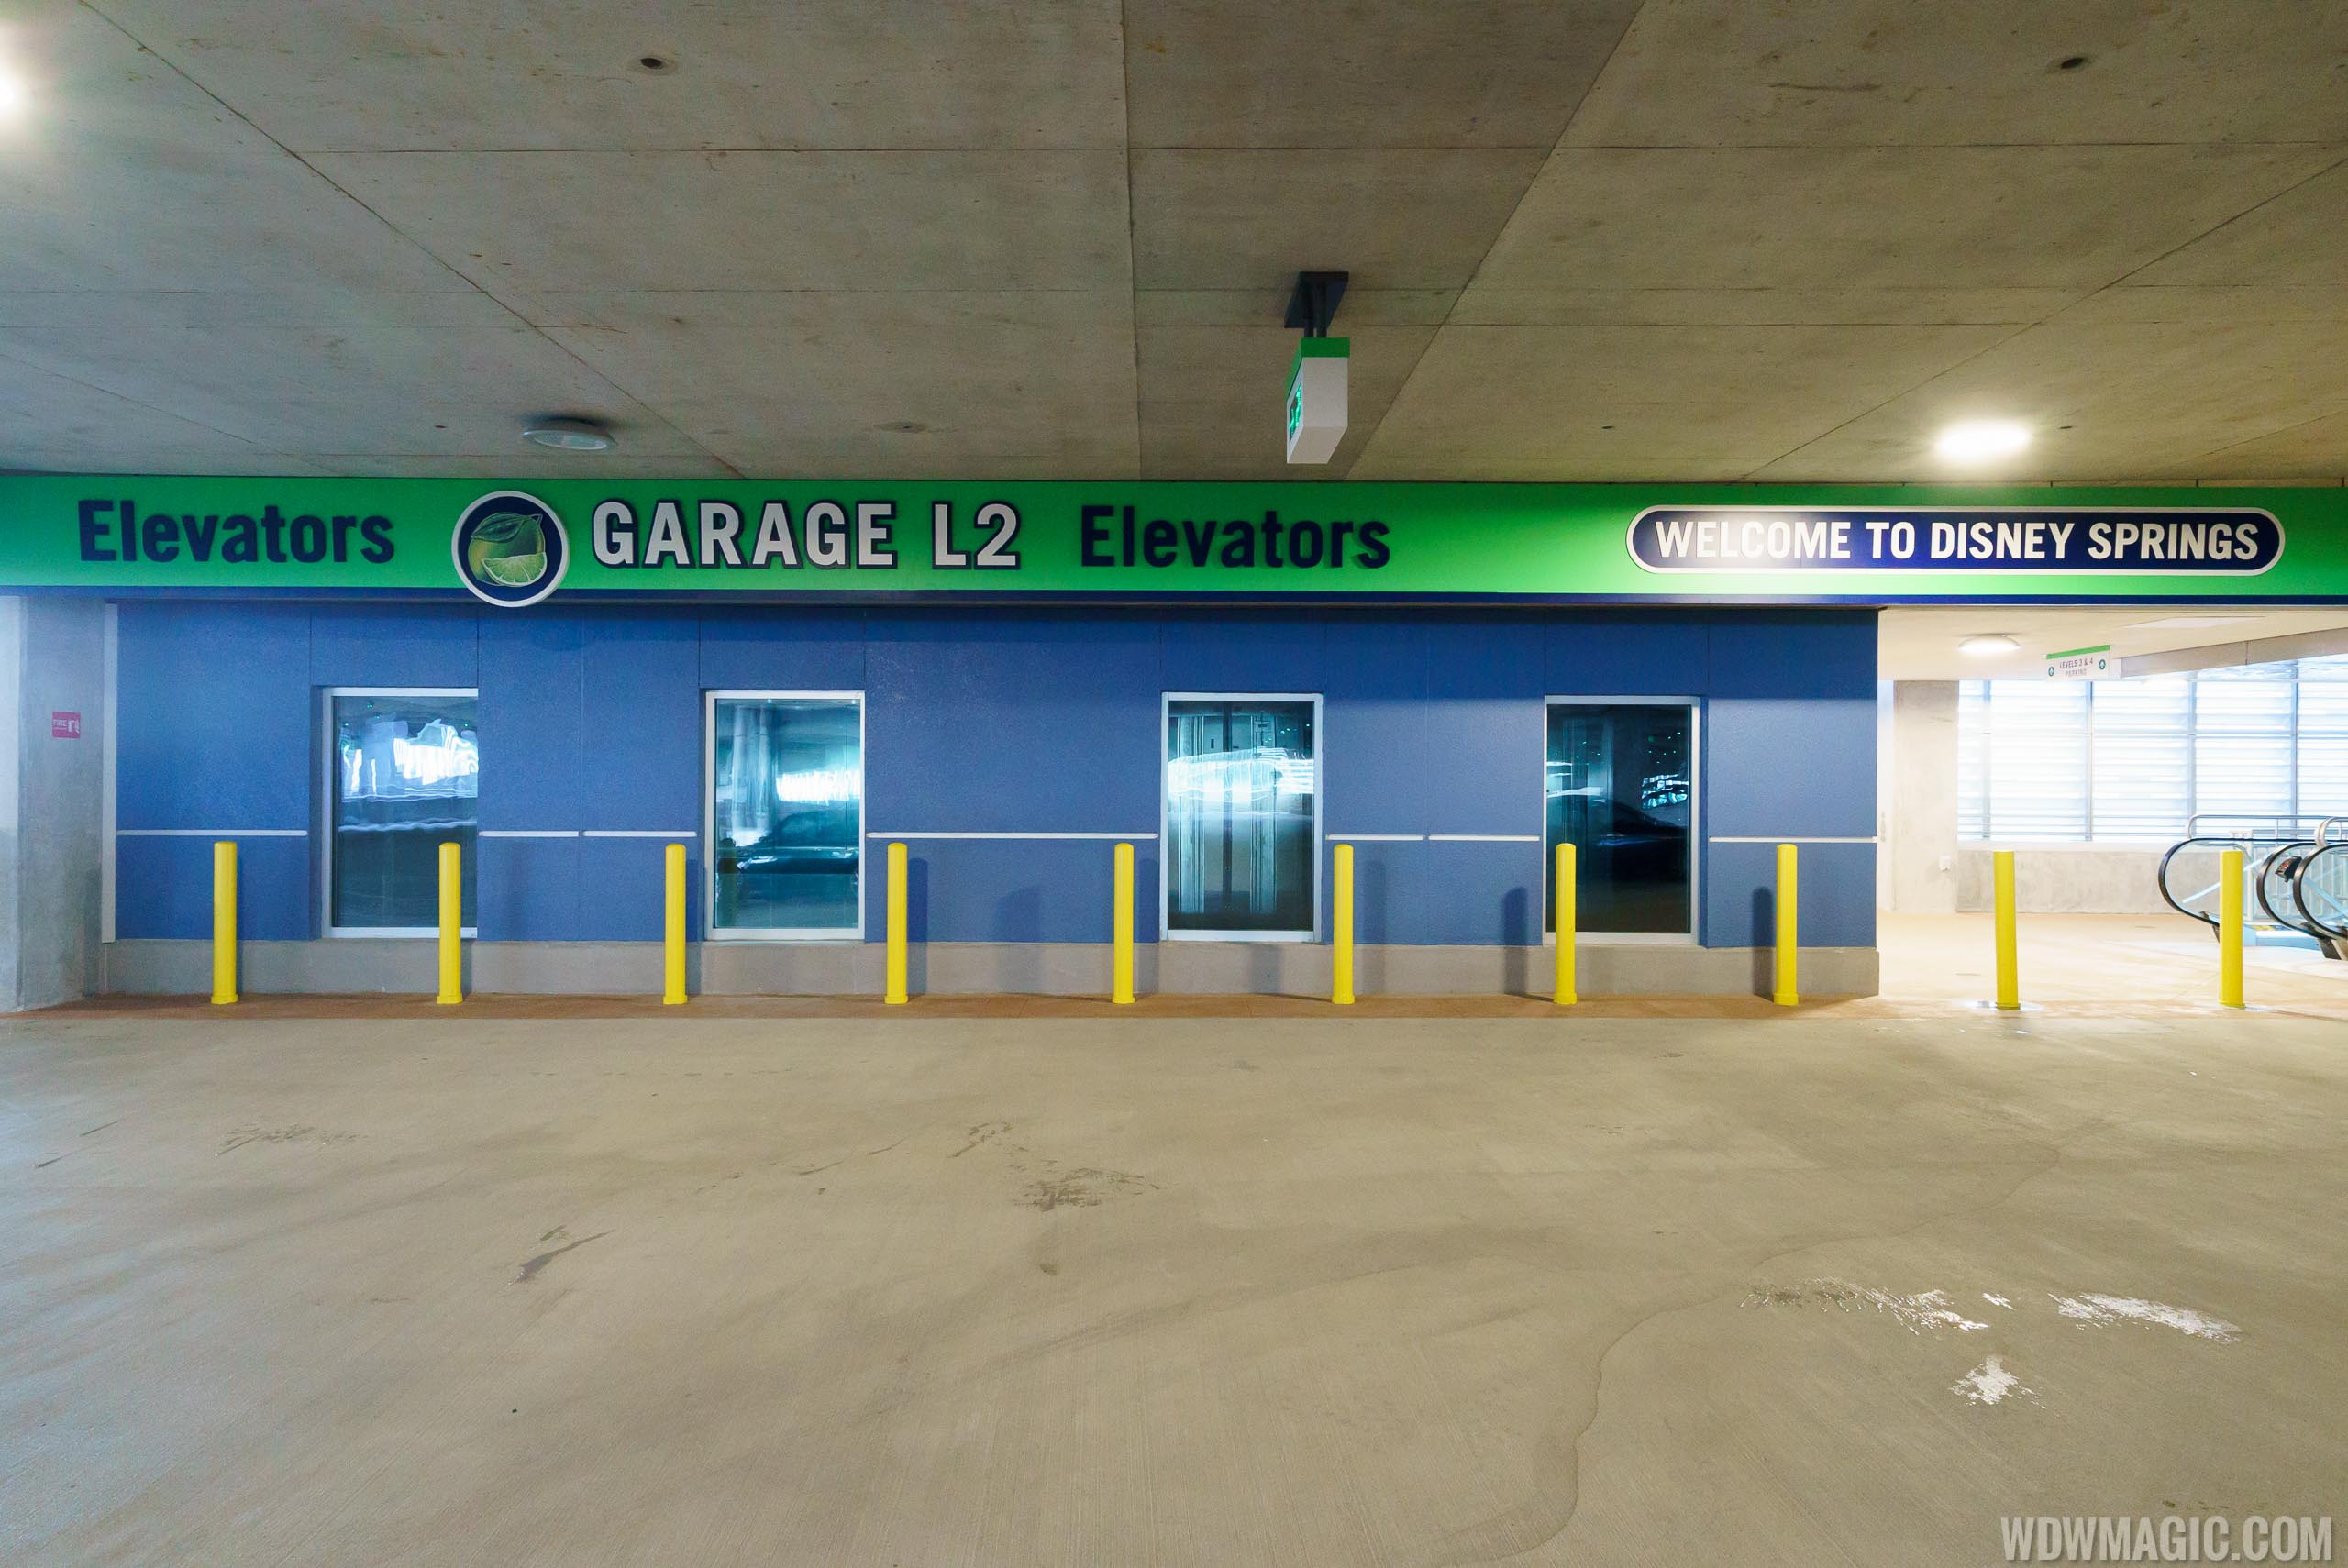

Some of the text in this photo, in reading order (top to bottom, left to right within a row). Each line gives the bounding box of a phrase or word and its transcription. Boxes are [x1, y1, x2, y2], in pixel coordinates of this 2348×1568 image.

[77, 499, 394, 564] Elevators
[591, 499, 1021, 569] GARAGE L2
[1080, 505, 1390, 569] Elevators
[1655, 520, 2260, 560] WELCOME TO DISNEY SPRINGS
[2060, 659, 2077, 669] LEVELS
[2084, 657, 2088, 666] &
[2065, 668, 2087, 677] PARKING
[53, 719, 67, 727] FIRE
